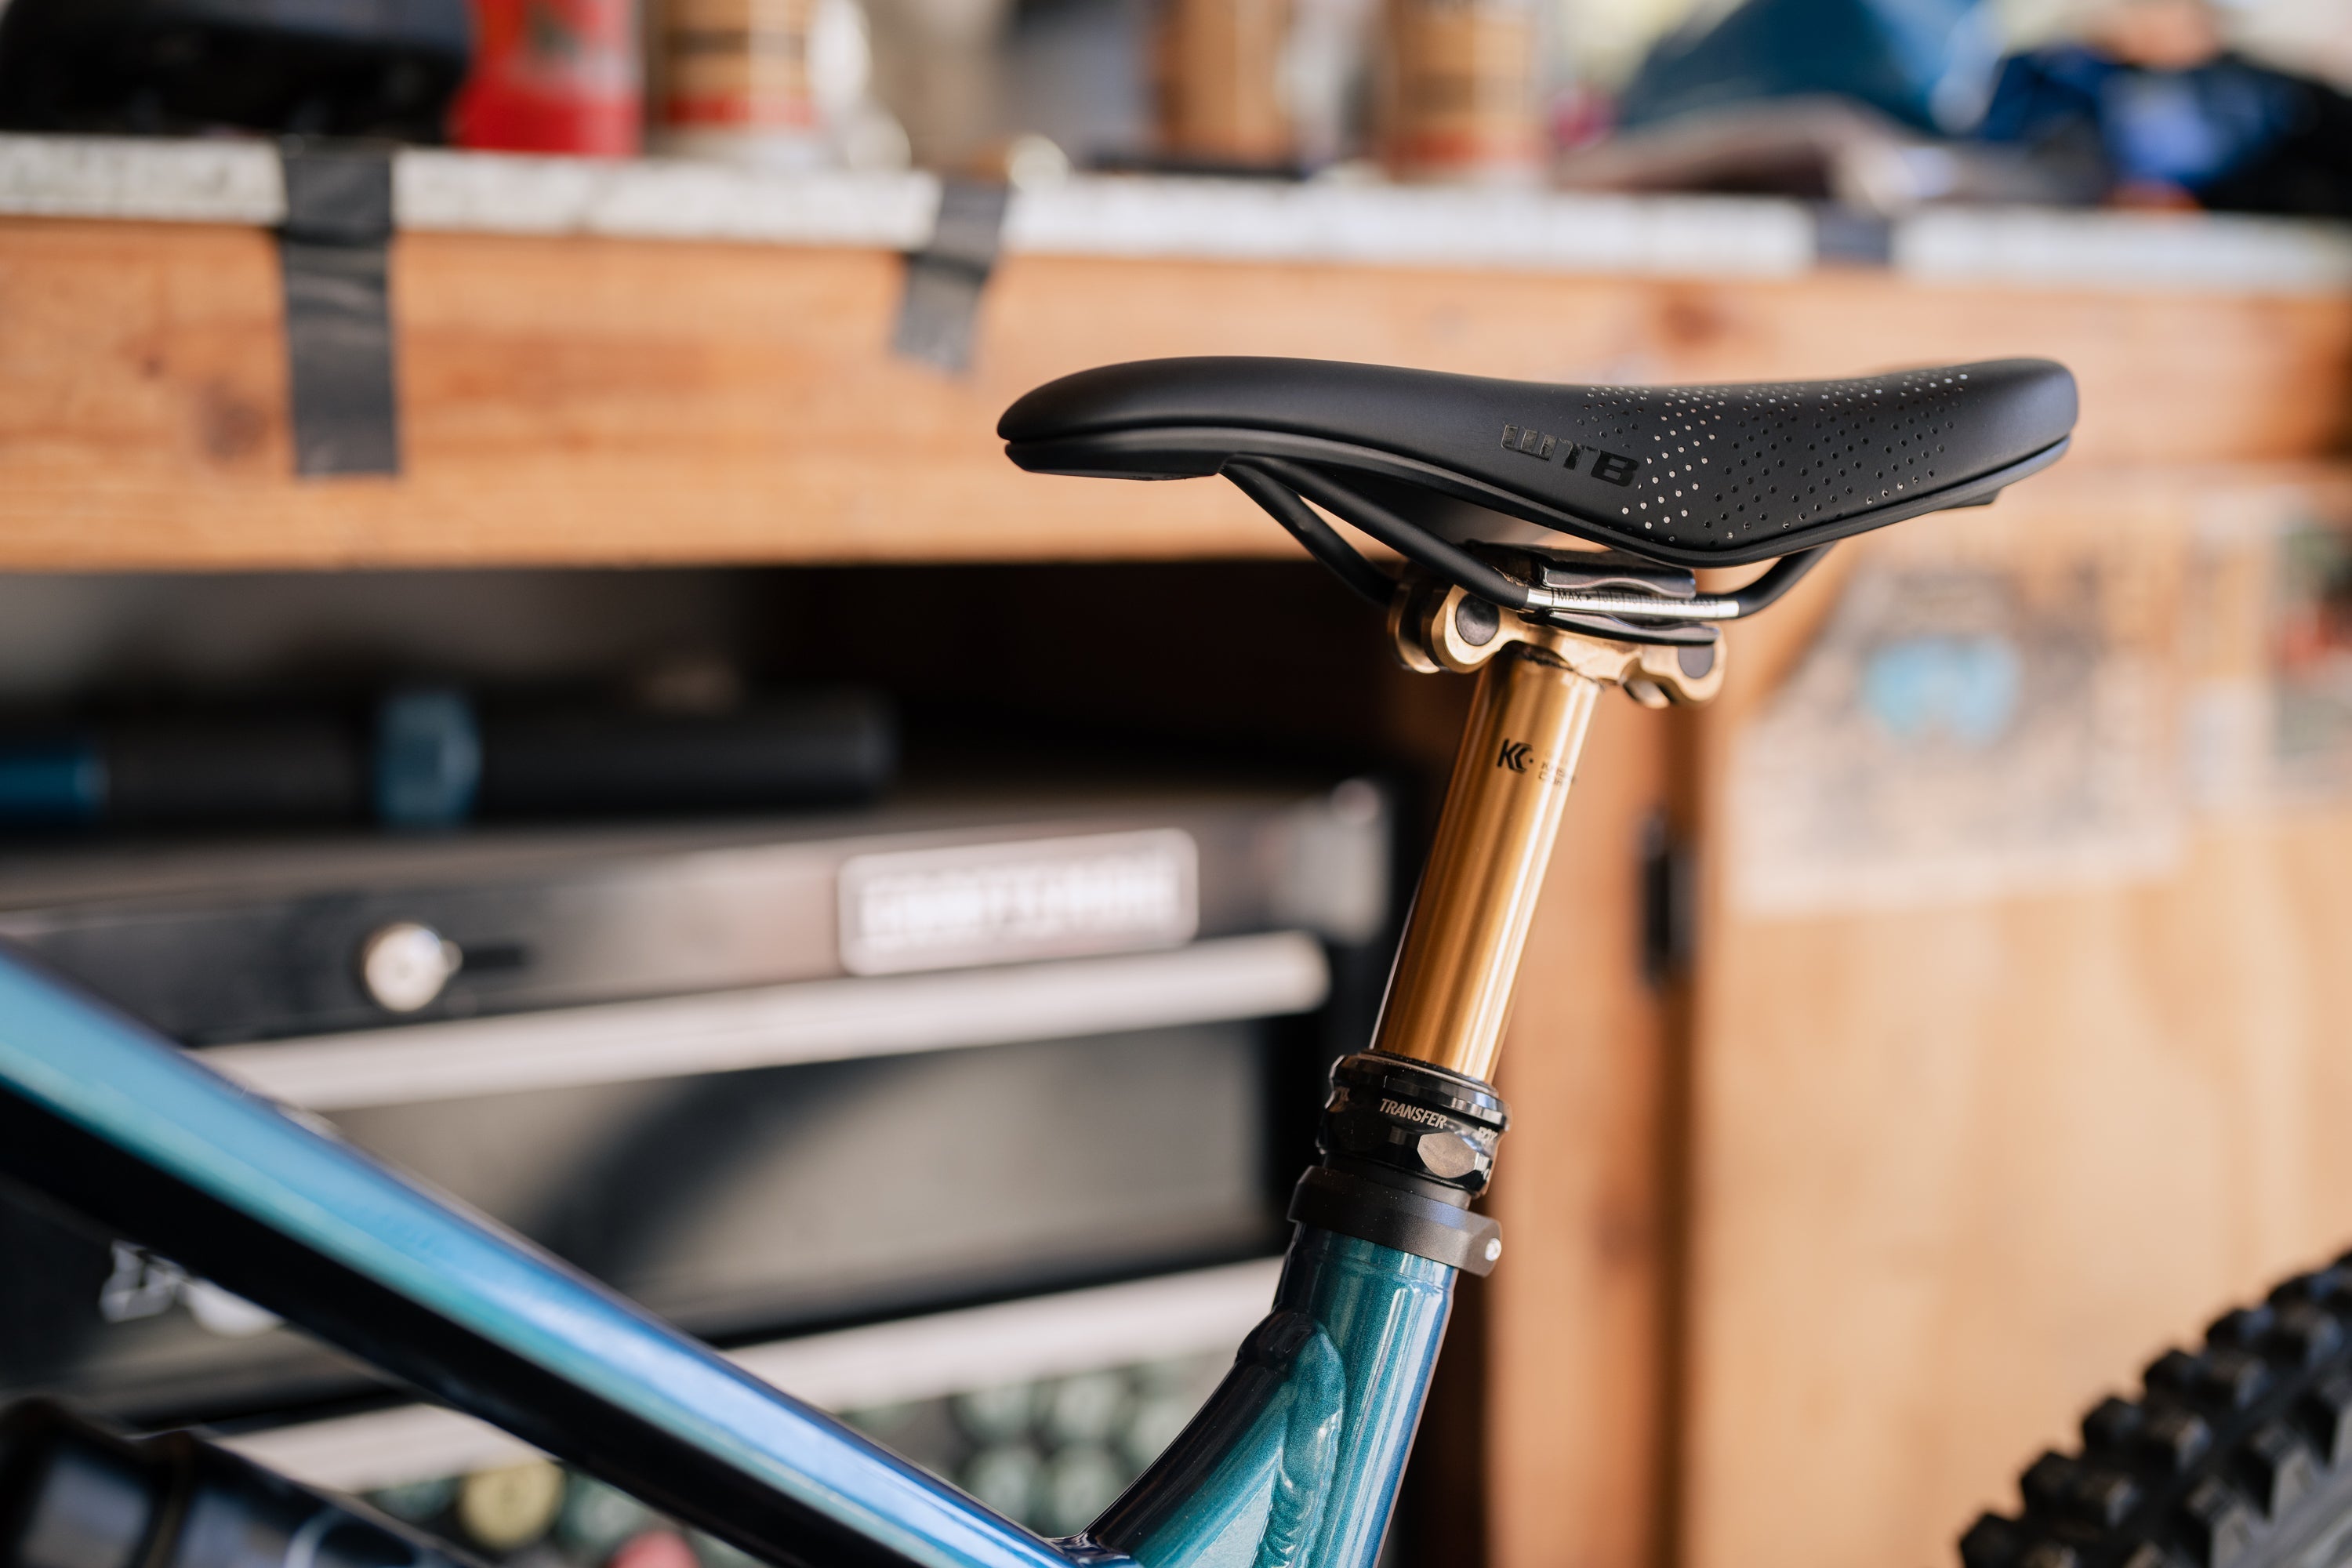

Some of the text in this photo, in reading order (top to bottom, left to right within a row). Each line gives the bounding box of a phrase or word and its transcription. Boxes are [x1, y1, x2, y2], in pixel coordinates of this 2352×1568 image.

[1501, 424, 1639, 488] WTB
[1557, 588, 1582, 602] MAX
[1379, 1098, 1449, 1130] TRANSFER
